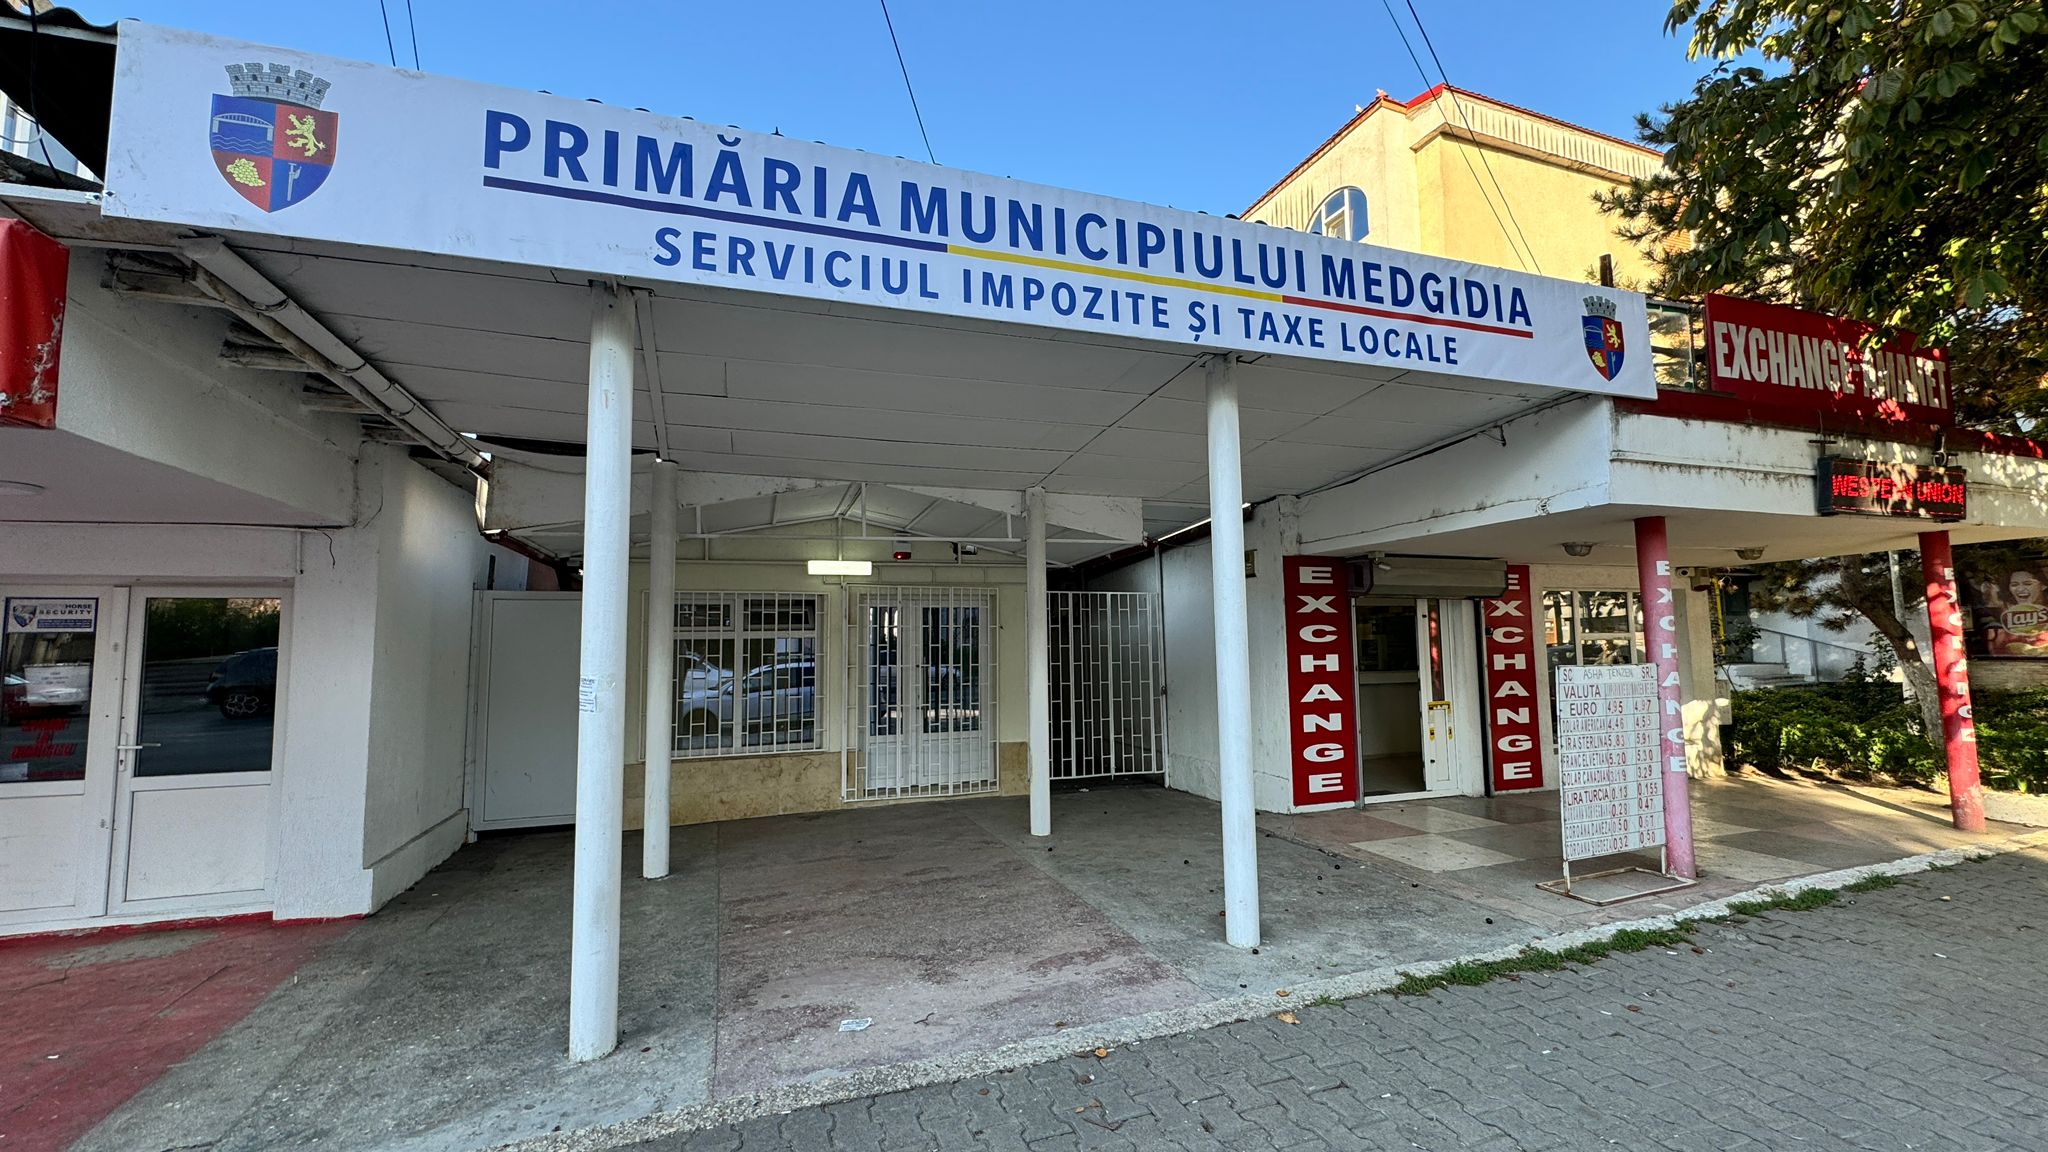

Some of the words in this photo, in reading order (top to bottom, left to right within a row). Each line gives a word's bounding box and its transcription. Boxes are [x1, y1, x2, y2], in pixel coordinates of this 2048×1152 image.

[484, 109, 881, 227] PRIMĂRIA
[900, 181, 1306, 292] MUNICIPIULUI
[1322, 254, 1533, 327] MEDGIDIA
[653, 226, 939, 300] SERVICIUL
[962, 268, 1170, 329] IMPOZITE
[1188, 301, 1221, 342] ȘI
[1237, 307, 1325, 349] TAXE
[1341, 322, 1459, 366] LOCALE
[1917, 481, 1964, 505] UNION
[1297, 566, 1345, 793] EXCHANGE
[1563, 668, 1573, 682] SC
[1642, 666, 1654, 679] SRL
[1563, 684, 1601, 699] VALUTA
[1570, 701, 1597, 716] EURO
[1608, 700, 1623, 714] 4.95
[1635, 699, 1651, 712] 4.97
[1609, 752, 1626, 765] 5.20
[1637, 749, 1653, 762] 5.30
[1638, 764, 1653, 779] 3.29
[1567, 791, 1583, 807] LIRA
[1584, 788, 1609, 803] TURCIA
[1612, 786, 1628, 800] 0.13
[1638, 782, 1657, 796] 0.155
